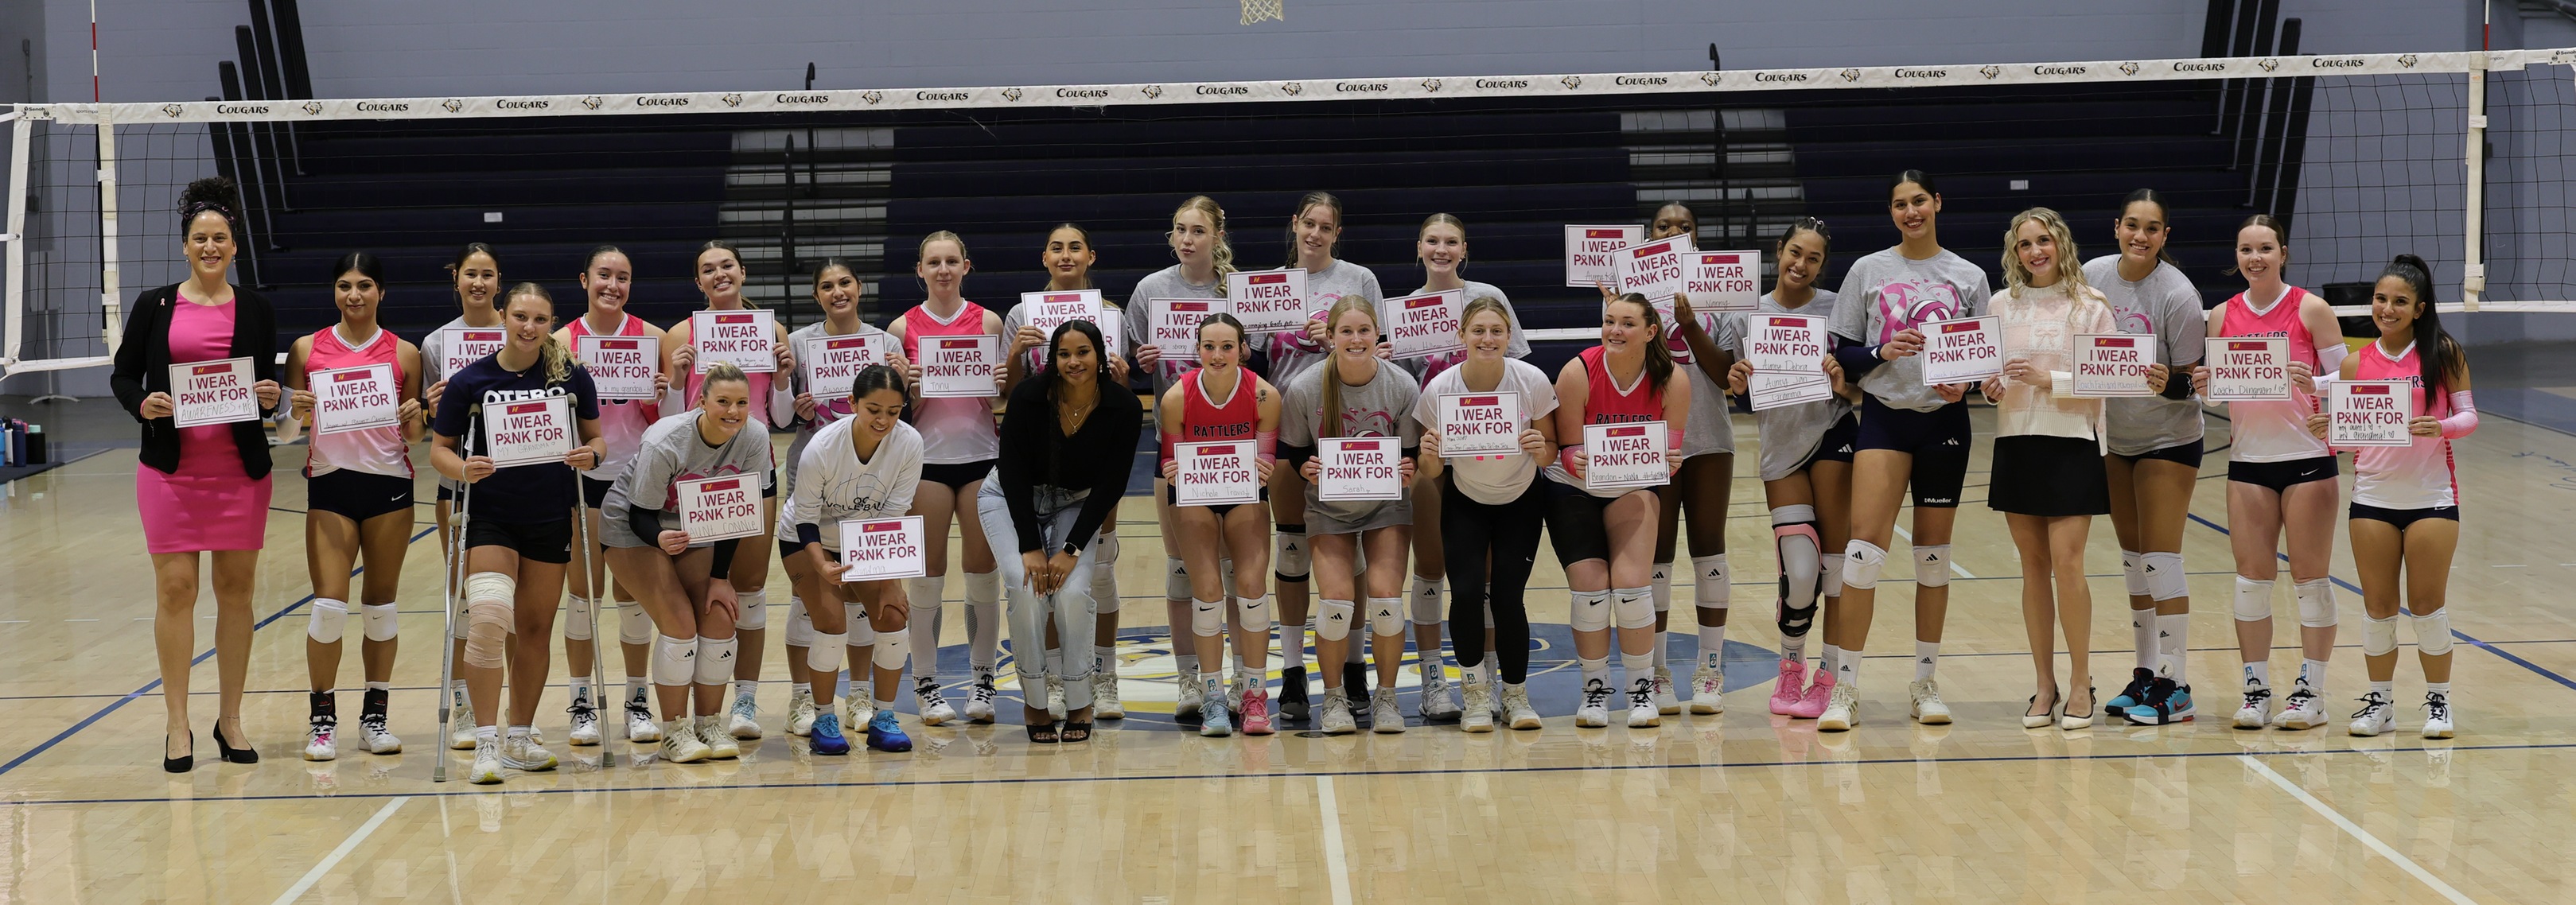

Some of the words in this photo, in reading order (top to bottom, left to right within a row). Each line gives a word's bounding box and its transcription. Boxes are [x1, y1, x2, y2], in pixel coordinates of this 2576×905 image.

[2173, 61, 2225, 72] COUGARS
[2312, 57, 2364, 68] COUGARS
[1894, 68, 1947, 78] COUGARS
[2033, 64, 2086, 75] COUGARS
[1476, 78, 1528, 88] COUGARS
[1615, 75, 1667, 85] COUGARS
[1755, 72, 1807, 82] COUGARS
[1056, 87, 1108, 98] COUGARS
[1196, 85, 1248, 95] COUGARS
[1336, 82, 1388, 92] COUGARS
[636, 96, 689, 107] COUGARS
[776, 93, 829, 103] COUGARS
[916, 91, 969, 101] COUGARS
[216, 104, 269, 115] COUGARS
[356, 101, 409, 111] COUGARS
[496, 99, 549, 109] COUGARS
[1582, 241, 1585, 252] I
[1631, 262, 1636, 274] I
[1637, 254, 1678, 271] WEAR
[1697, 267, 1700, 278] I
[1704, 266, 1743, 278] WEAR
[1245, 288, 1248, 299] I
[1252, 285, 1291, 298] WEAR
[1726, 280, 1753, 292] FOR
[1041, 305, 1044, 315] I
[1047, 304, 1086, 315] WEAR
[1274, 299, 1301, 311] FOR
[1165, 314, 1169, 324] I
[1402, 313, 1406, 324] I
[1408, 307, 1448, 323] WEAR
[711, 327, 714, 339] I
[718, 326, 757, 338] WEAR
[1432, 320, 1459, 333] FOR
[1764, 329, 1767, 340] I
[1771, 329, 1810, 342] WEAR
[1938, 337, 1941, 348] I
[1945, 332, 1986, 348] WEAR
[458, 344, 461, 355] I
[741, 340, 768, 352] FOR
[1793, 344, 1819, 356] FOR
[595, 352, 598, 363] I
[602, 352, 641, 363] WEAR
[823, 353, 827, 364] I
[831, 350, 870, 363] WEAR
[936, 352, 939, 363] I
[943, 352, 982, 363] WEAR
[1969, 346, 1996, 359] FOR
[2090, 350, 2093, 361] I
[2097, 350, 2138, 362] WEAR
[2224, 354, 2228, 365] I
[2232, 353, 2272, 364] WEAR
[625, 367, 649, 378] FOR
[965, 364, 991, 375] FOR
[2119, 365, 2146, 377] FOR
[2255, 367, 2282, 379] FOR
[189, 379, 193, 390] I
[196, 375, 237, 390] WEAR
[931, 382, 950, 392] Tony
[220, 388, 248, 401] FOR
[330, 386, 334, 398] I
[337, 381, 378, 396] WEAR
[2213, 385, 2233, 394] Coach
[362, 394, 389, 407] FOR
[2346, 398, 2349, 409] I
[2353, 398, 2393, 409] WEAR
[181, 402, 236, 420] AWARENESS
[1455, 410, 1458, 421] I
[1462, 408, 1502, 421] WEAR
[503, 418, 508, 430] I
[511, 414, 552, 429] WEAR
[2376, 412, 2403, 424] FOR
[1193, 422, 1250, 437] RATTLERS
[1486, 421, 1512, 434] FOR
[535, 428, 563, 441] FOR
[517, 442, 549, 453] GRANDMA
[1602, 441, 1605, 452] I
[1609, 438, 1650, 452] WEAR
[1193, 459, 1197, 470] I
[1200, 457, 1239, 469] WEAR
[1337, 453, 1340, 465] I
[1344, 453, 1383, 464] WEAR
[1632, 452, 1660, 464] FOR
[1224, 471, 1250, 483] FOR
[1367, 467, 1393, 479] FOR
[1592, 472, 1617, 481] Brandon
[1192, 487, 1218, 498] Nichole
[1343, 484, 1364, 493] Sarah
[697, 496, 701, 507] I
[704, 491, 745, 507] WEAR
[728, 504, 755, 518] FOR
[858, 536, 862, 547] I
[866, 533, 906, 546] WEAR
[889, 546, 916, 558] FOR
